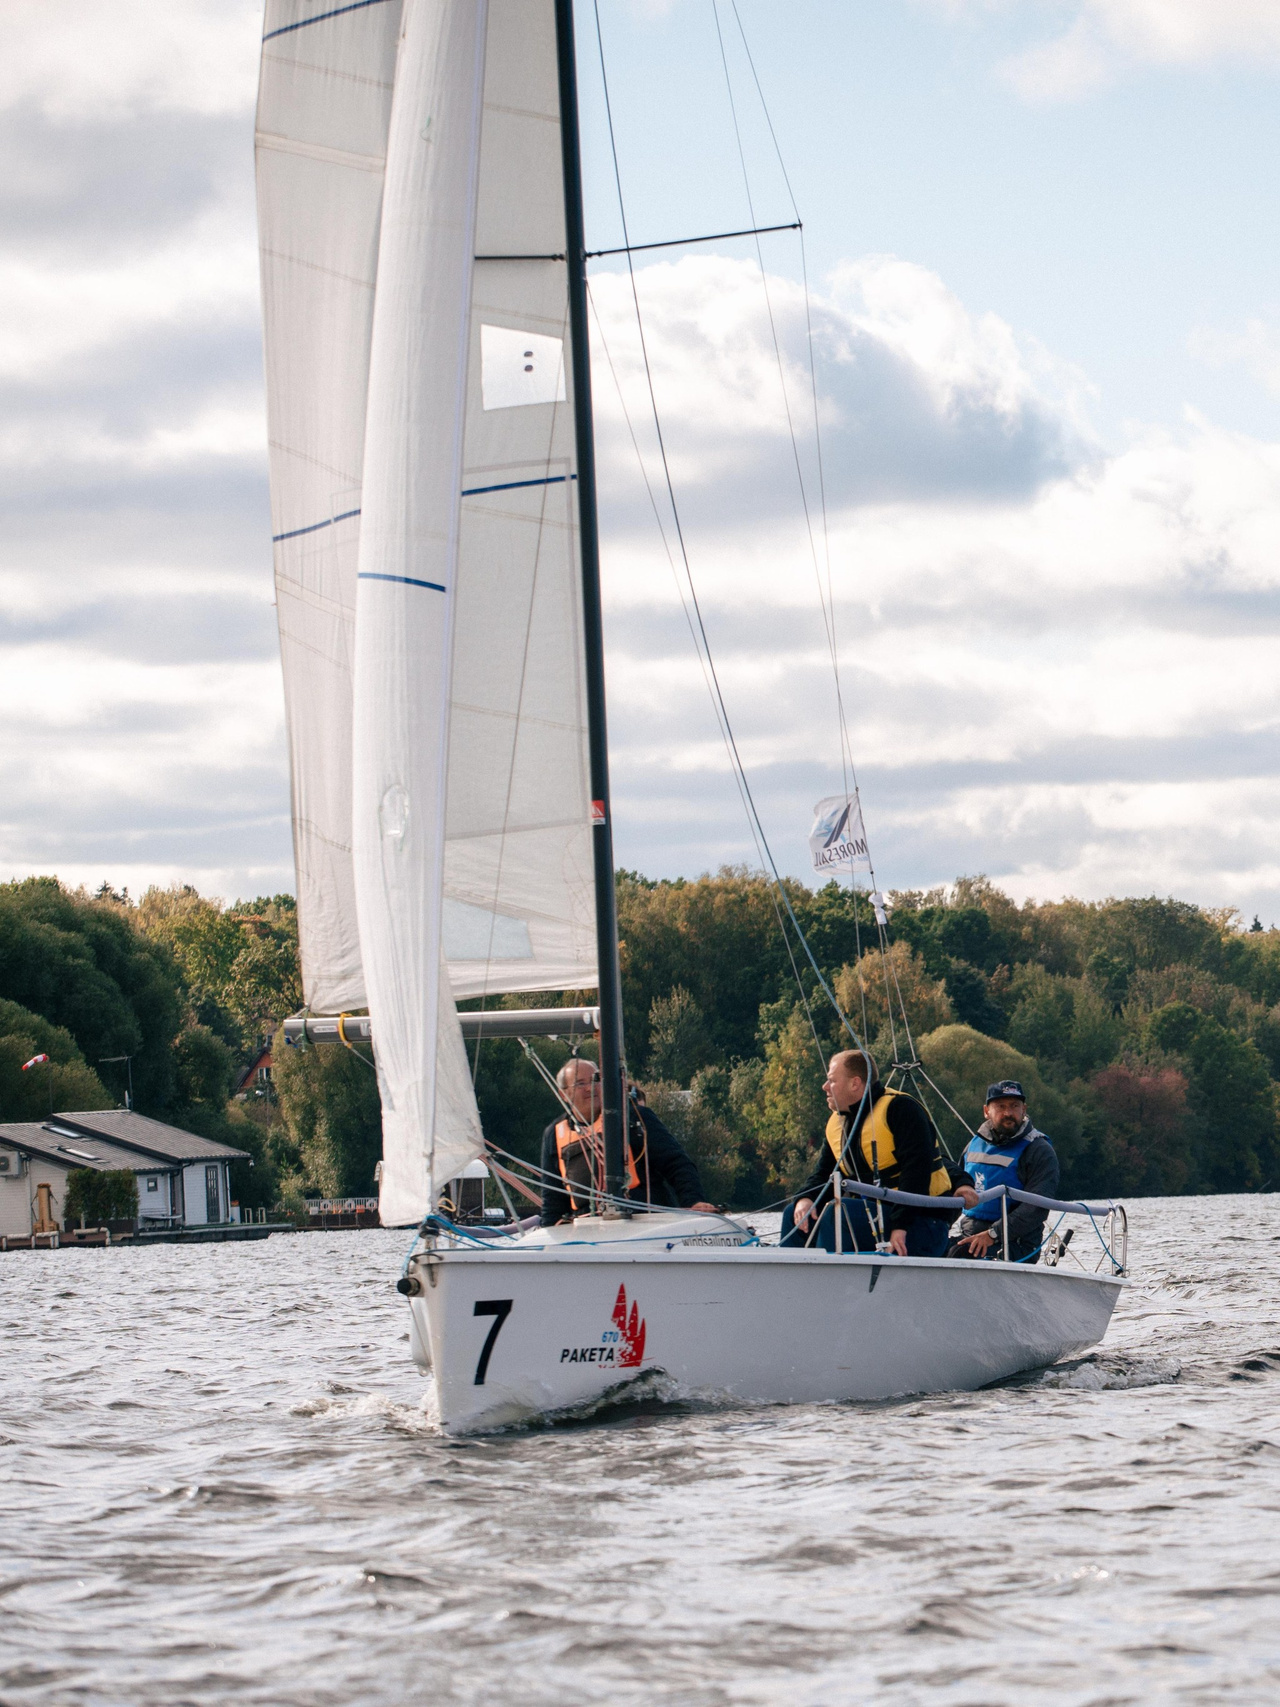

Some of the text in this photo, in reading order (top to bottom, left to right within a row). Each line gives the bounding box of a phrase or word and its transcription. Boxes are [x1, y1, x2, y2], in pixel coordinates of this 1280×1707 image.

[473, 1299, 513, 1385] 7
[602, 1331, 618, 1343] 670
[560, 1347, 614, 1363] PAKETA
